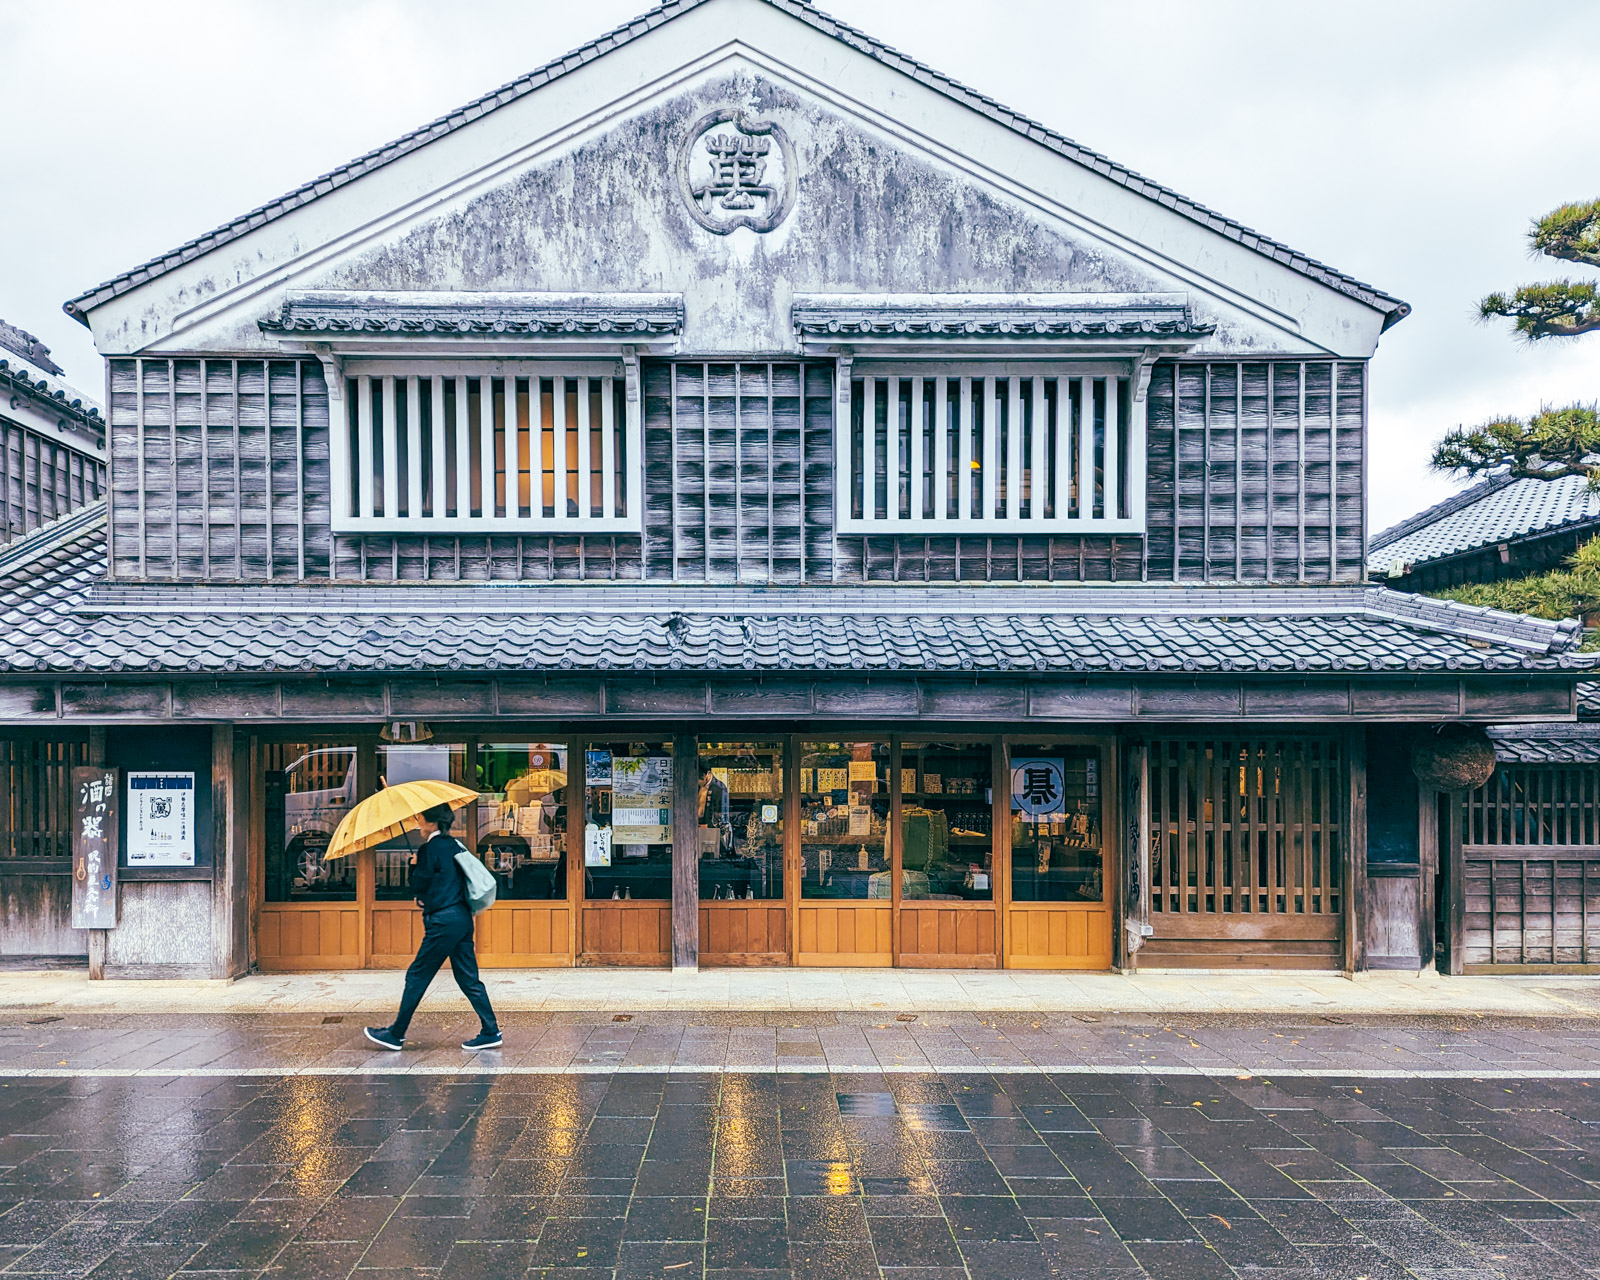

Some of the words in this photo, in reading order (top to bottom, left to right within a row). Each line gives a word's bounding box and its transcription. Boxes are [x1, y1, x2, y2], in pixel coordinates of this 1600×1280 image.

[658, 759, 670, 805] 日本酒の宴
[80, 780, 107, 838] 酒の器
